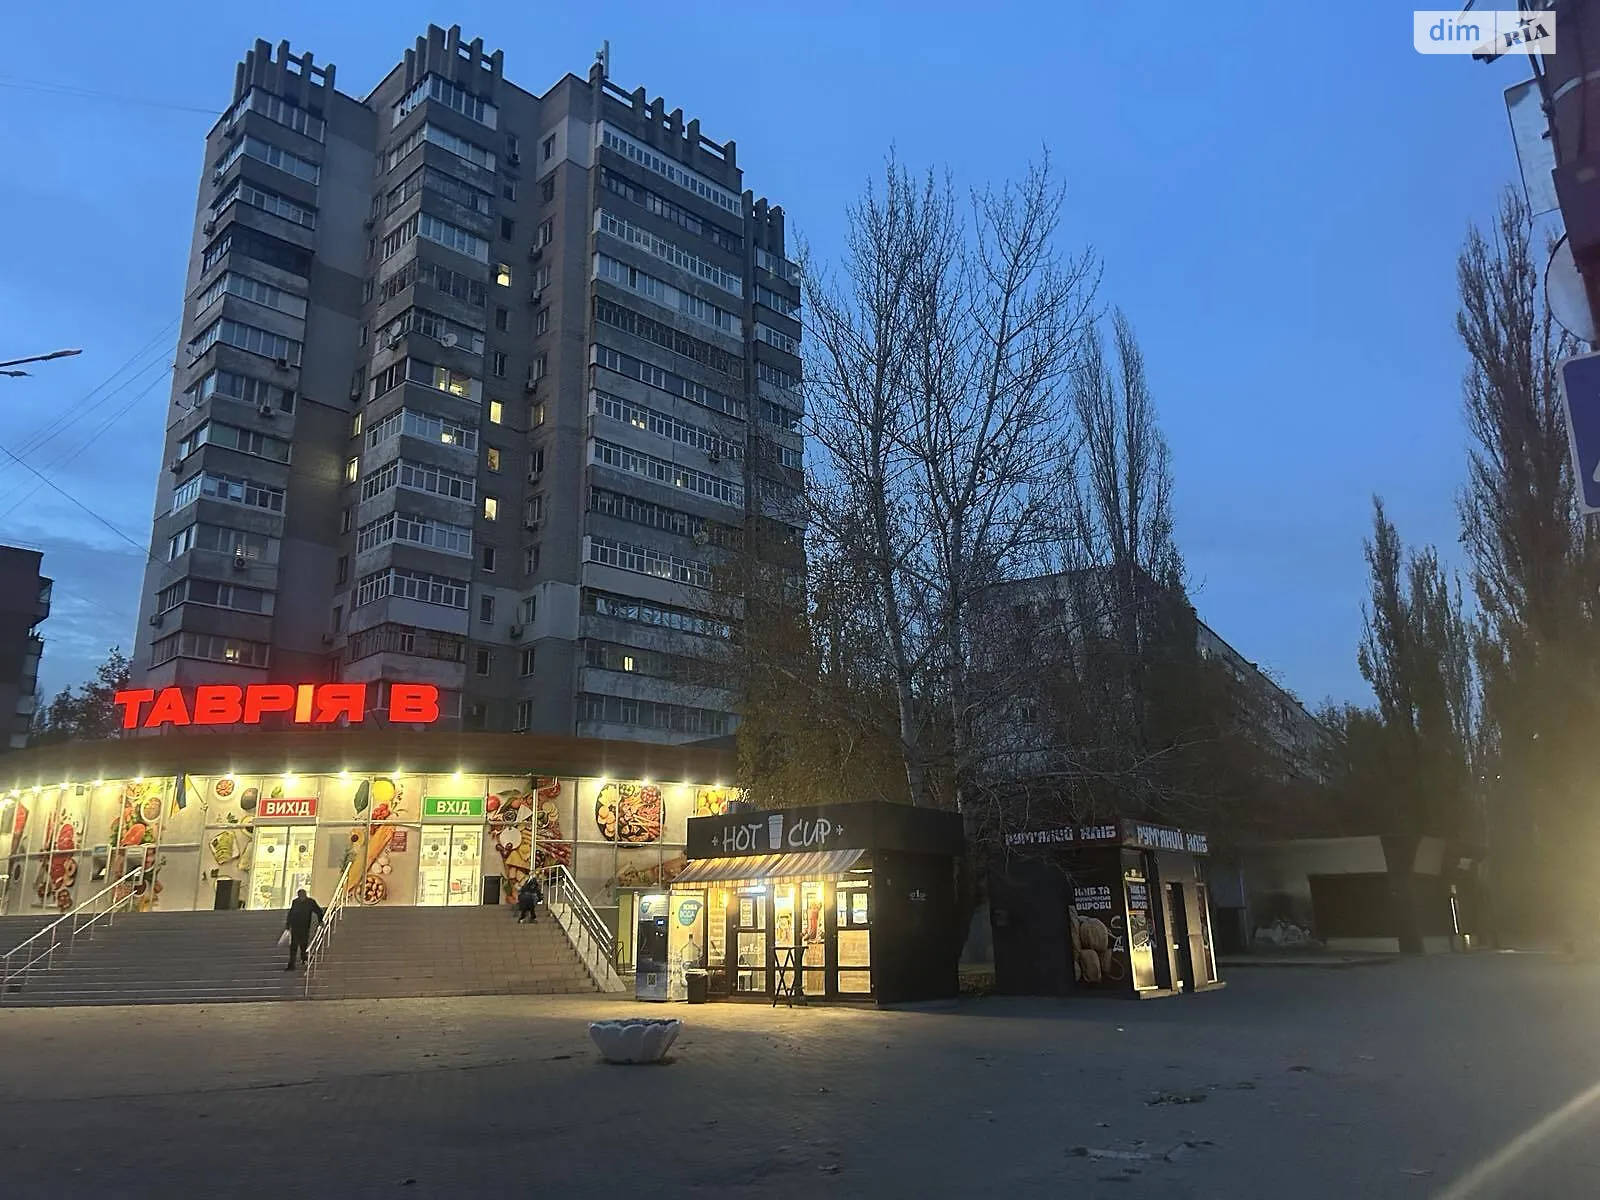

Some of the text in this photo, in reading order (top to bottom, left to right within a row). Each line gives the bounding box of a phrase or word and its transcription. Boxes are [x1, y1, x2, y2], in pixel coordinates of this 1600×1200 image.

[114, 683, 440, 729] ТАВРІЯ В
[266, 801, 310, 816] ВИХІД
[436, 800, 471, 815] ВХІД
[722, 818, 831, 852] HOT CUP
